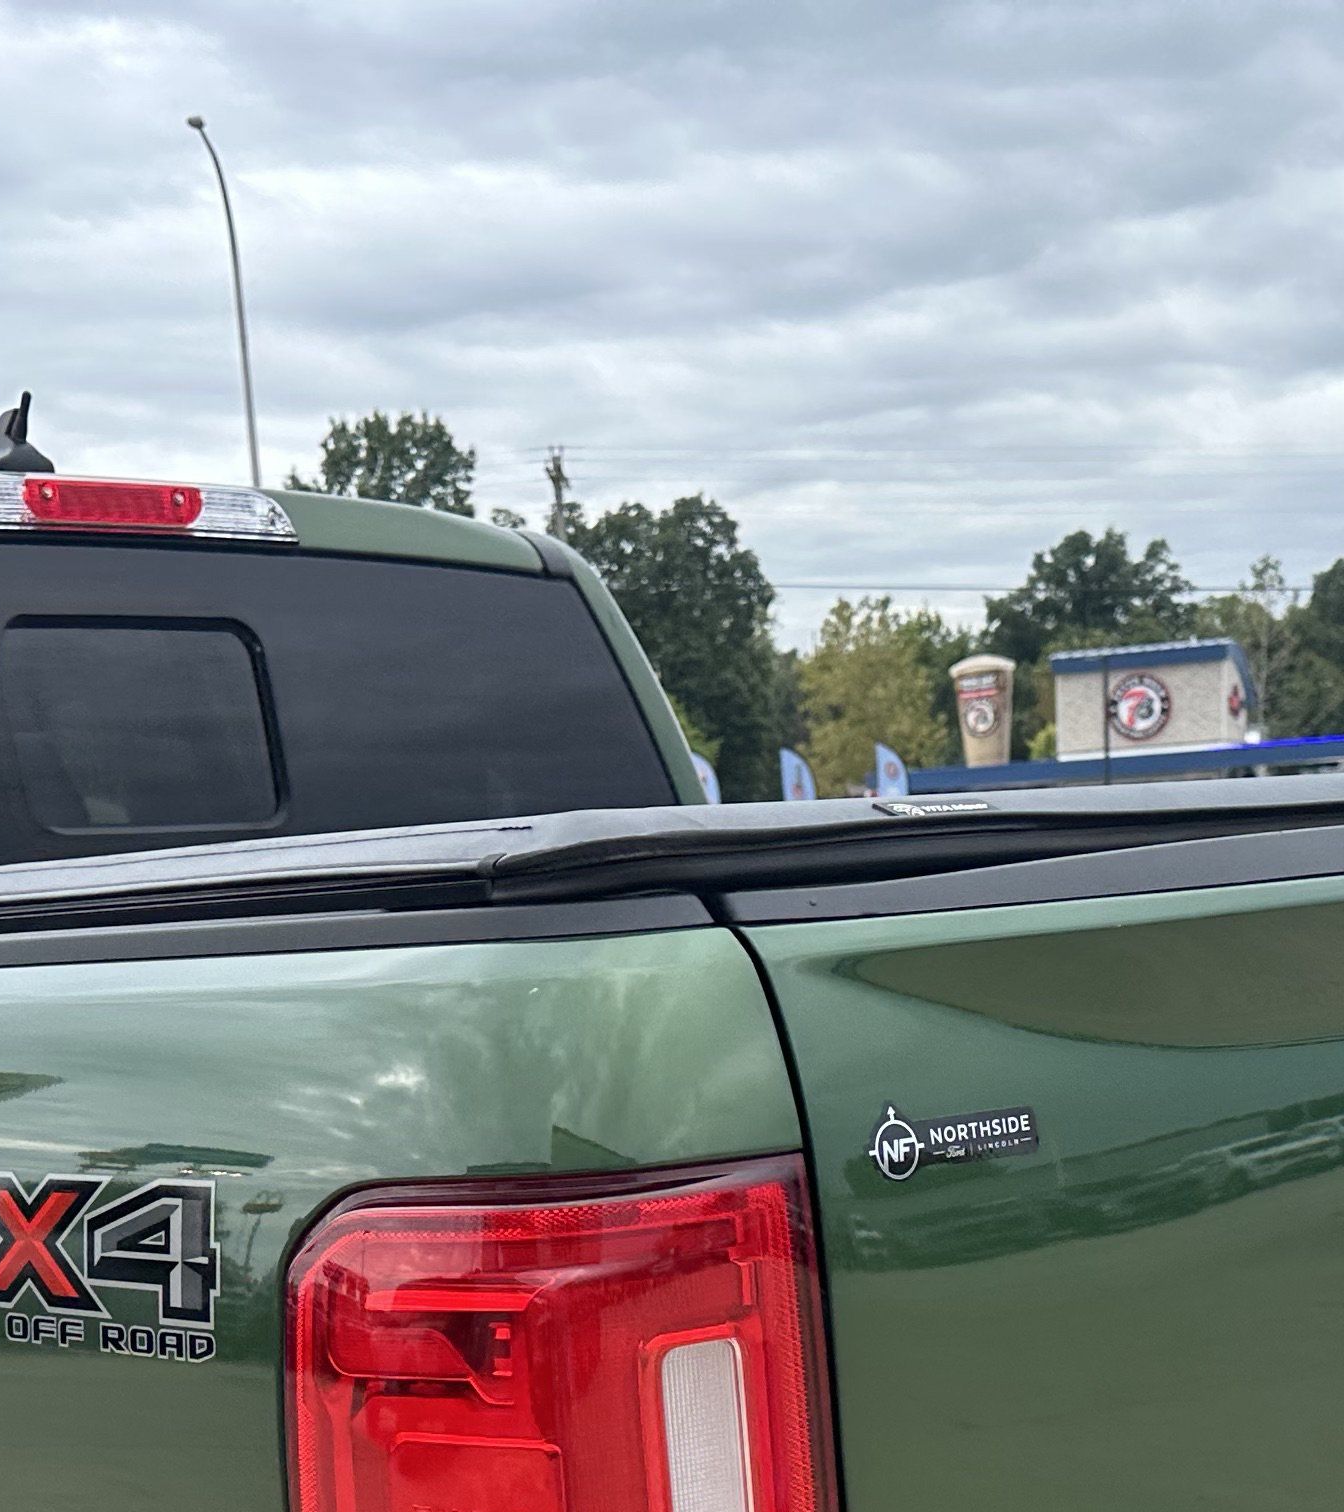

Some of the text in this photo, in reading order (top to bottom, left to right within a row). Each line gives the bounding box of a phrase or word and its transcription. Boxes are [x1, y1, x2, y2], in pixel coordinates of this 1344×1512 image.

[929, 1114, 1031, 1145] NORTHSIDE
[977, 1138, 1019, 1151] LINCOLN
[5, 1312, 217, 1363] OFF ROAD
